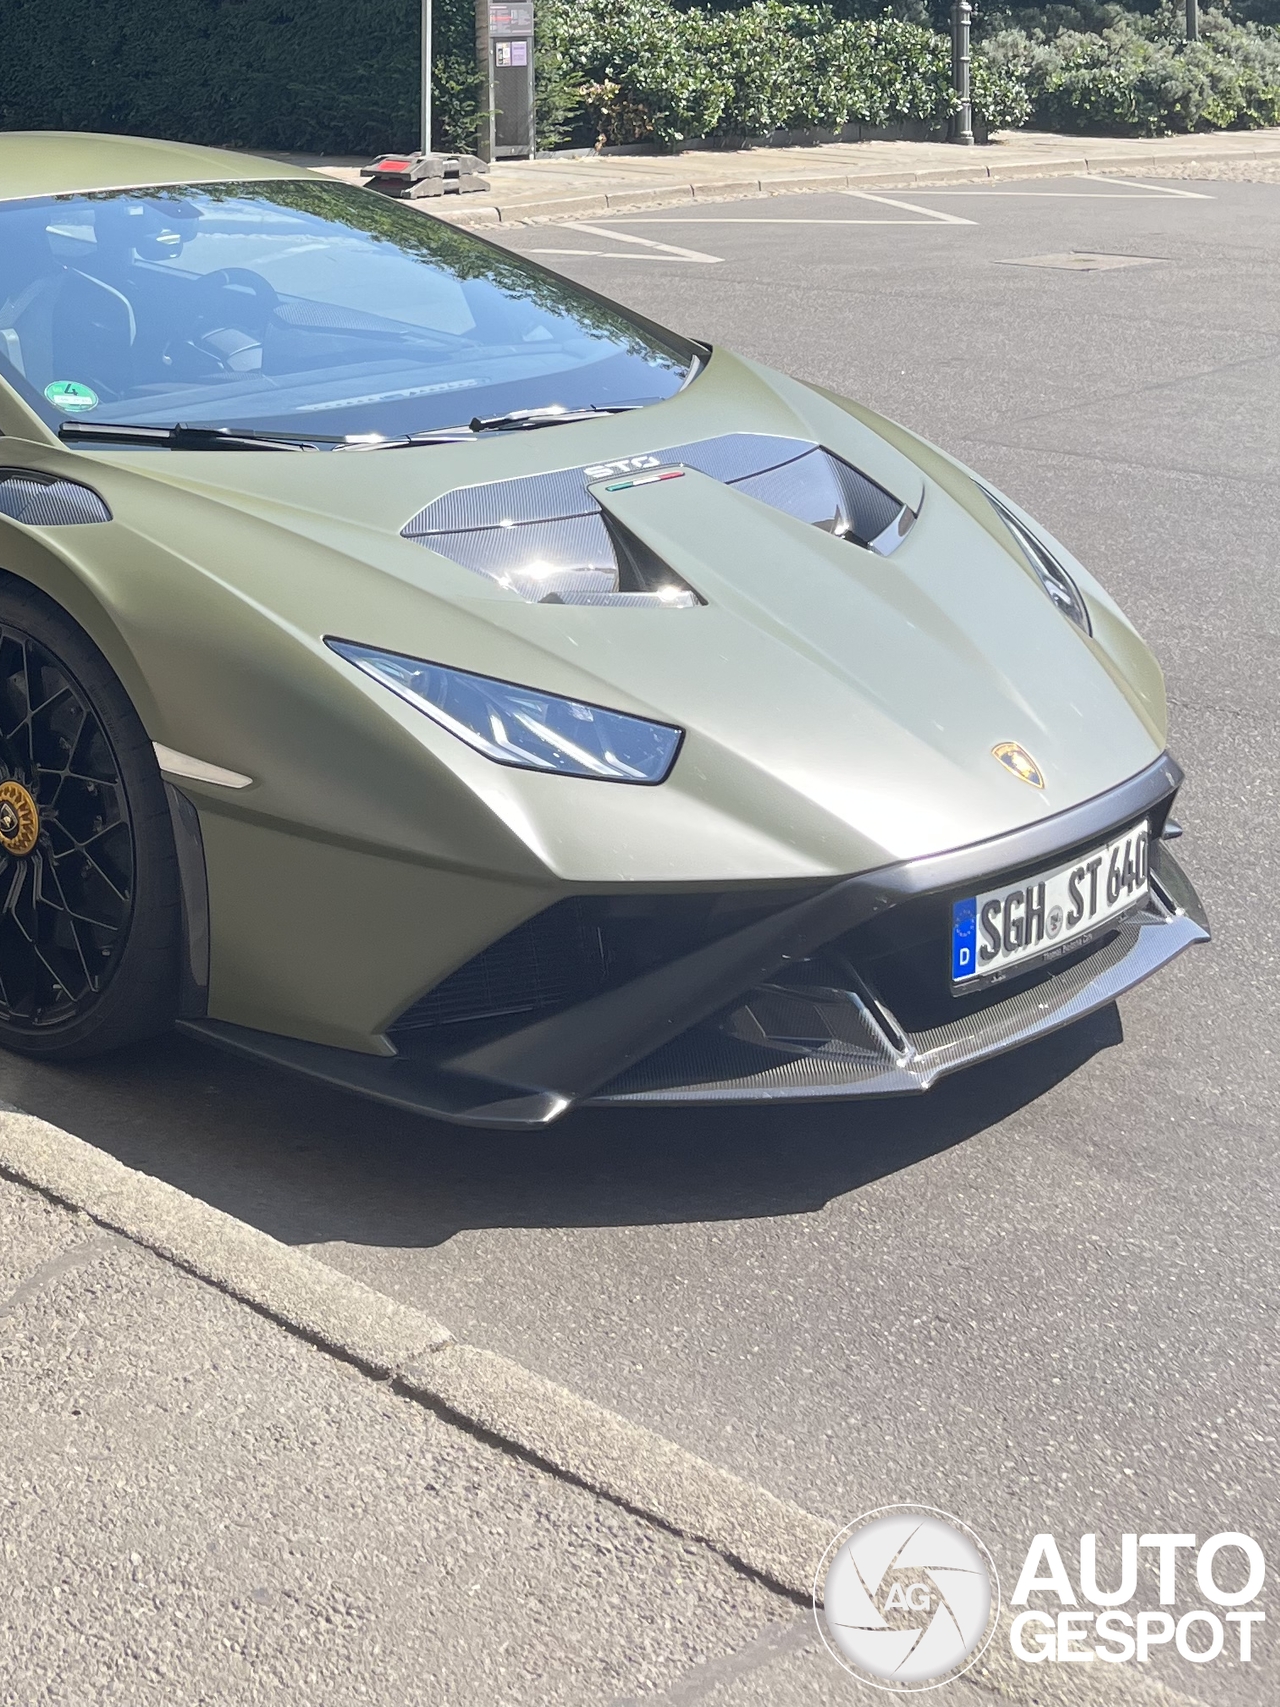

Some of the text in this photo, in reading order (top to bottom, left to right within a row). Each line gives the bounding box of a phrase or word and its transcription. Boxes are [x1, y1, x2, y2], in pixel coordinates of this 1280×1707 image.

[64, 383, 78, 396] 4
[583, 456, 660, 478] STO
[979, 831, 1148, 961] SGH ST 640
[959, 948, 970, 966] D
